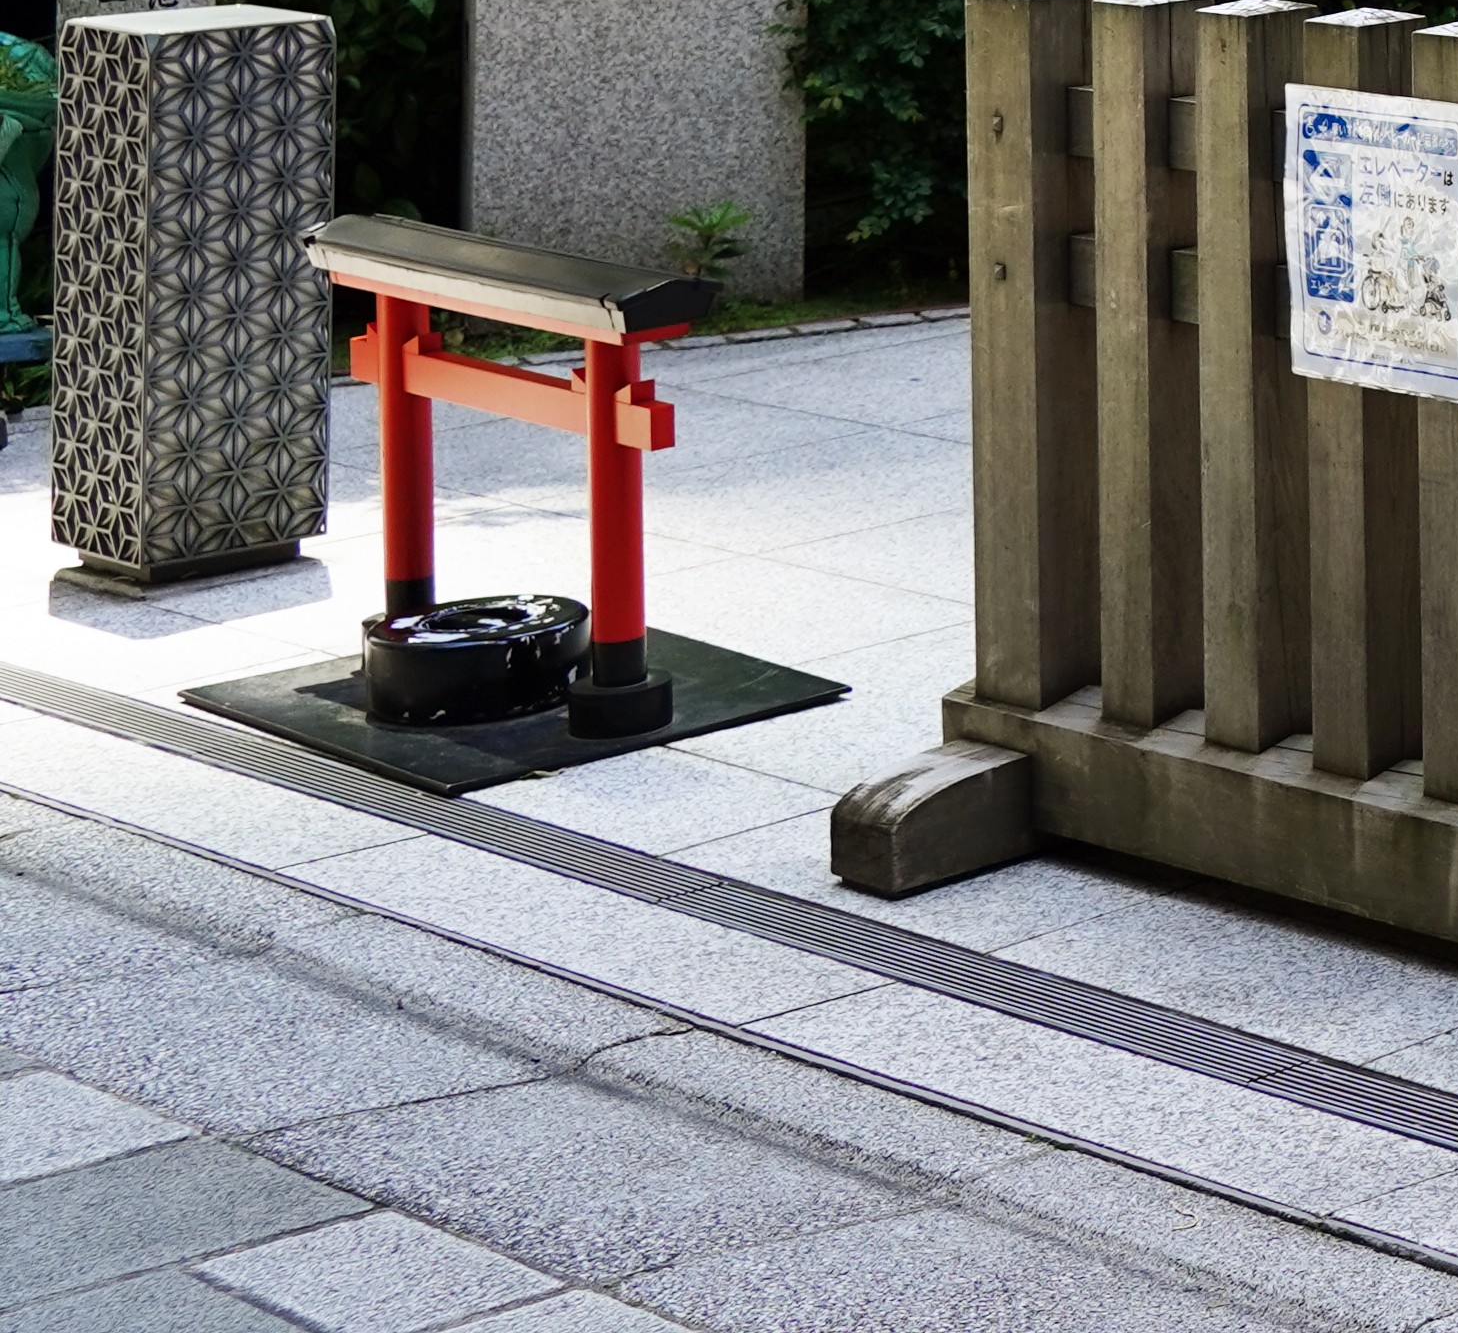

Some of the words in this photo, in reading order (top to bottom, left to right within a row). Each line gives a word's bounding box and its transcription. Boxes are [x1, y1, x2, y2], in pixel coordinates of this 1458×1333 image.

[1359, 154, 1454, 187] エレベーターは
[1359, 183, 1451, 217] 左側にあります
